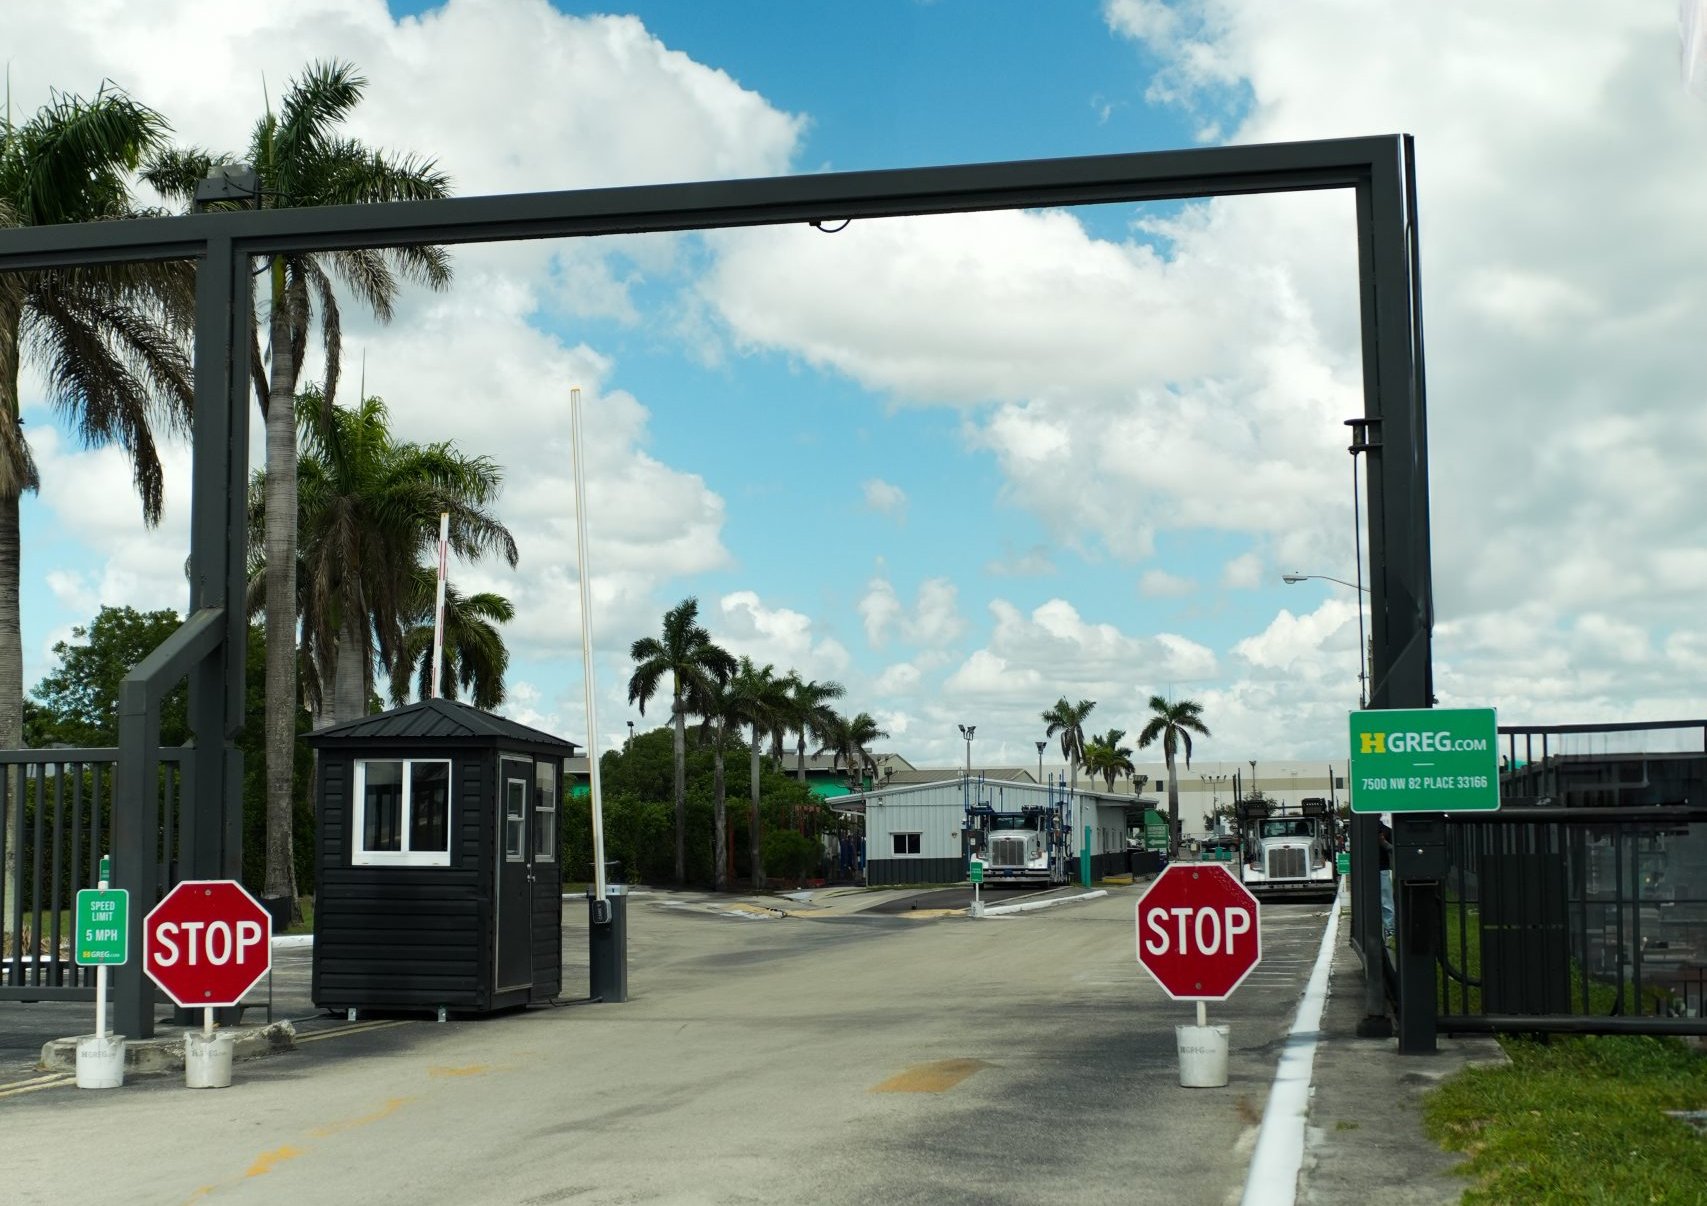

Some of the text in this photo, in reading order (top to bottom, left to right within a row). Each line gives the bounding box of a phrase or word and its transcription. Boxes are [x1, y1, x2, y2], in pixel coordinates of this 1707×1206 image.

[1362, 775, 1488, 791] 7500 NW 82 PLACE 33166
[90, 901, 115, 911] SPEED
[91, 911, 114, 922] LIMIT
[86, 929, 118, 942] 5 MPH
[1145, 906, 1251, 956] STOP
[153, 920, 262, 967] STOP
